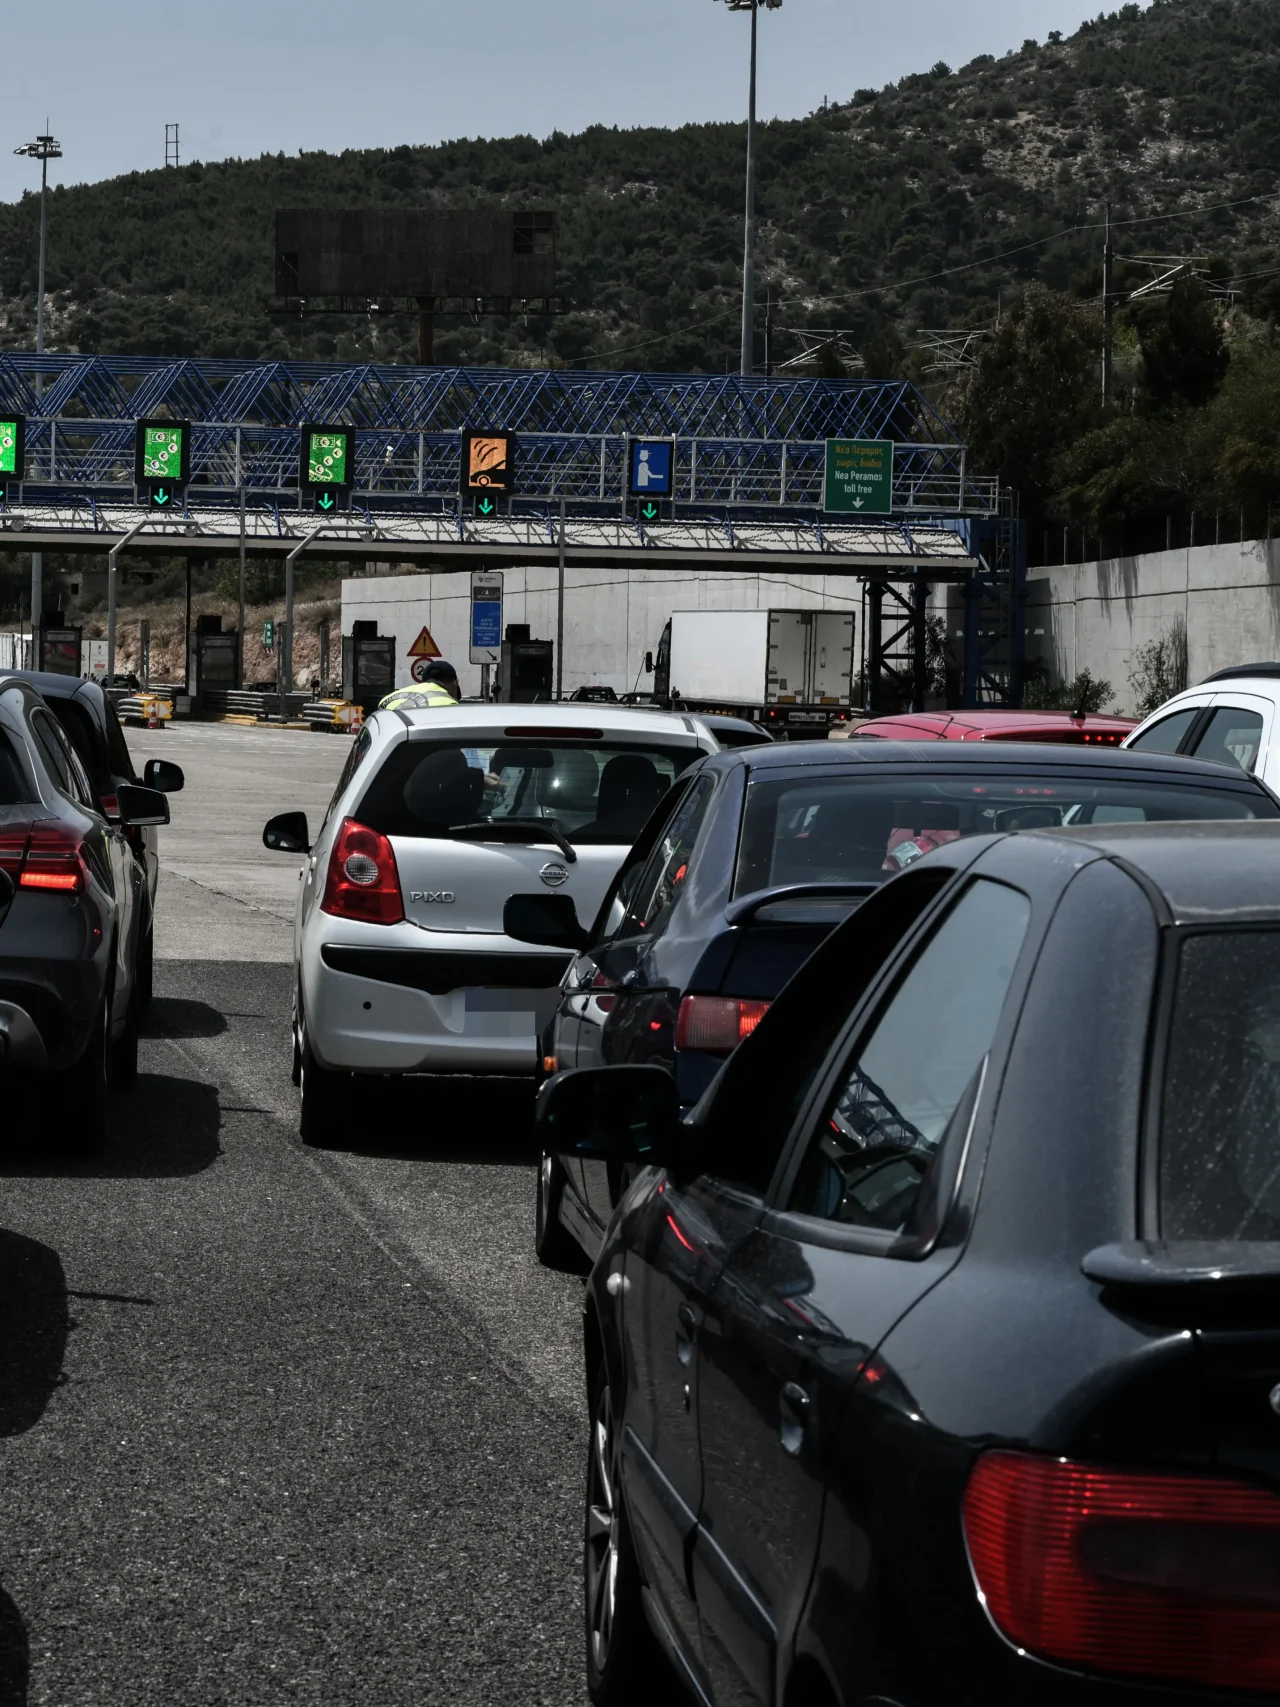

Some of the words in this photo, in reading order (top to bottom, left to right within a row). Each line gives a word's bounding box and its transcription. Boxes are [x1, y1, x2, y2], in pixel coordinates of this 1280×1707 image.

[835, 470, 849, 479] Nea
[850, 471, 883, 481] Peramos
[844, 484, 855, 492] toll
[857, 484, 872, 493] free
[416, 665, 424, 676] 2
[409, 891, 455, 903] PIXO
